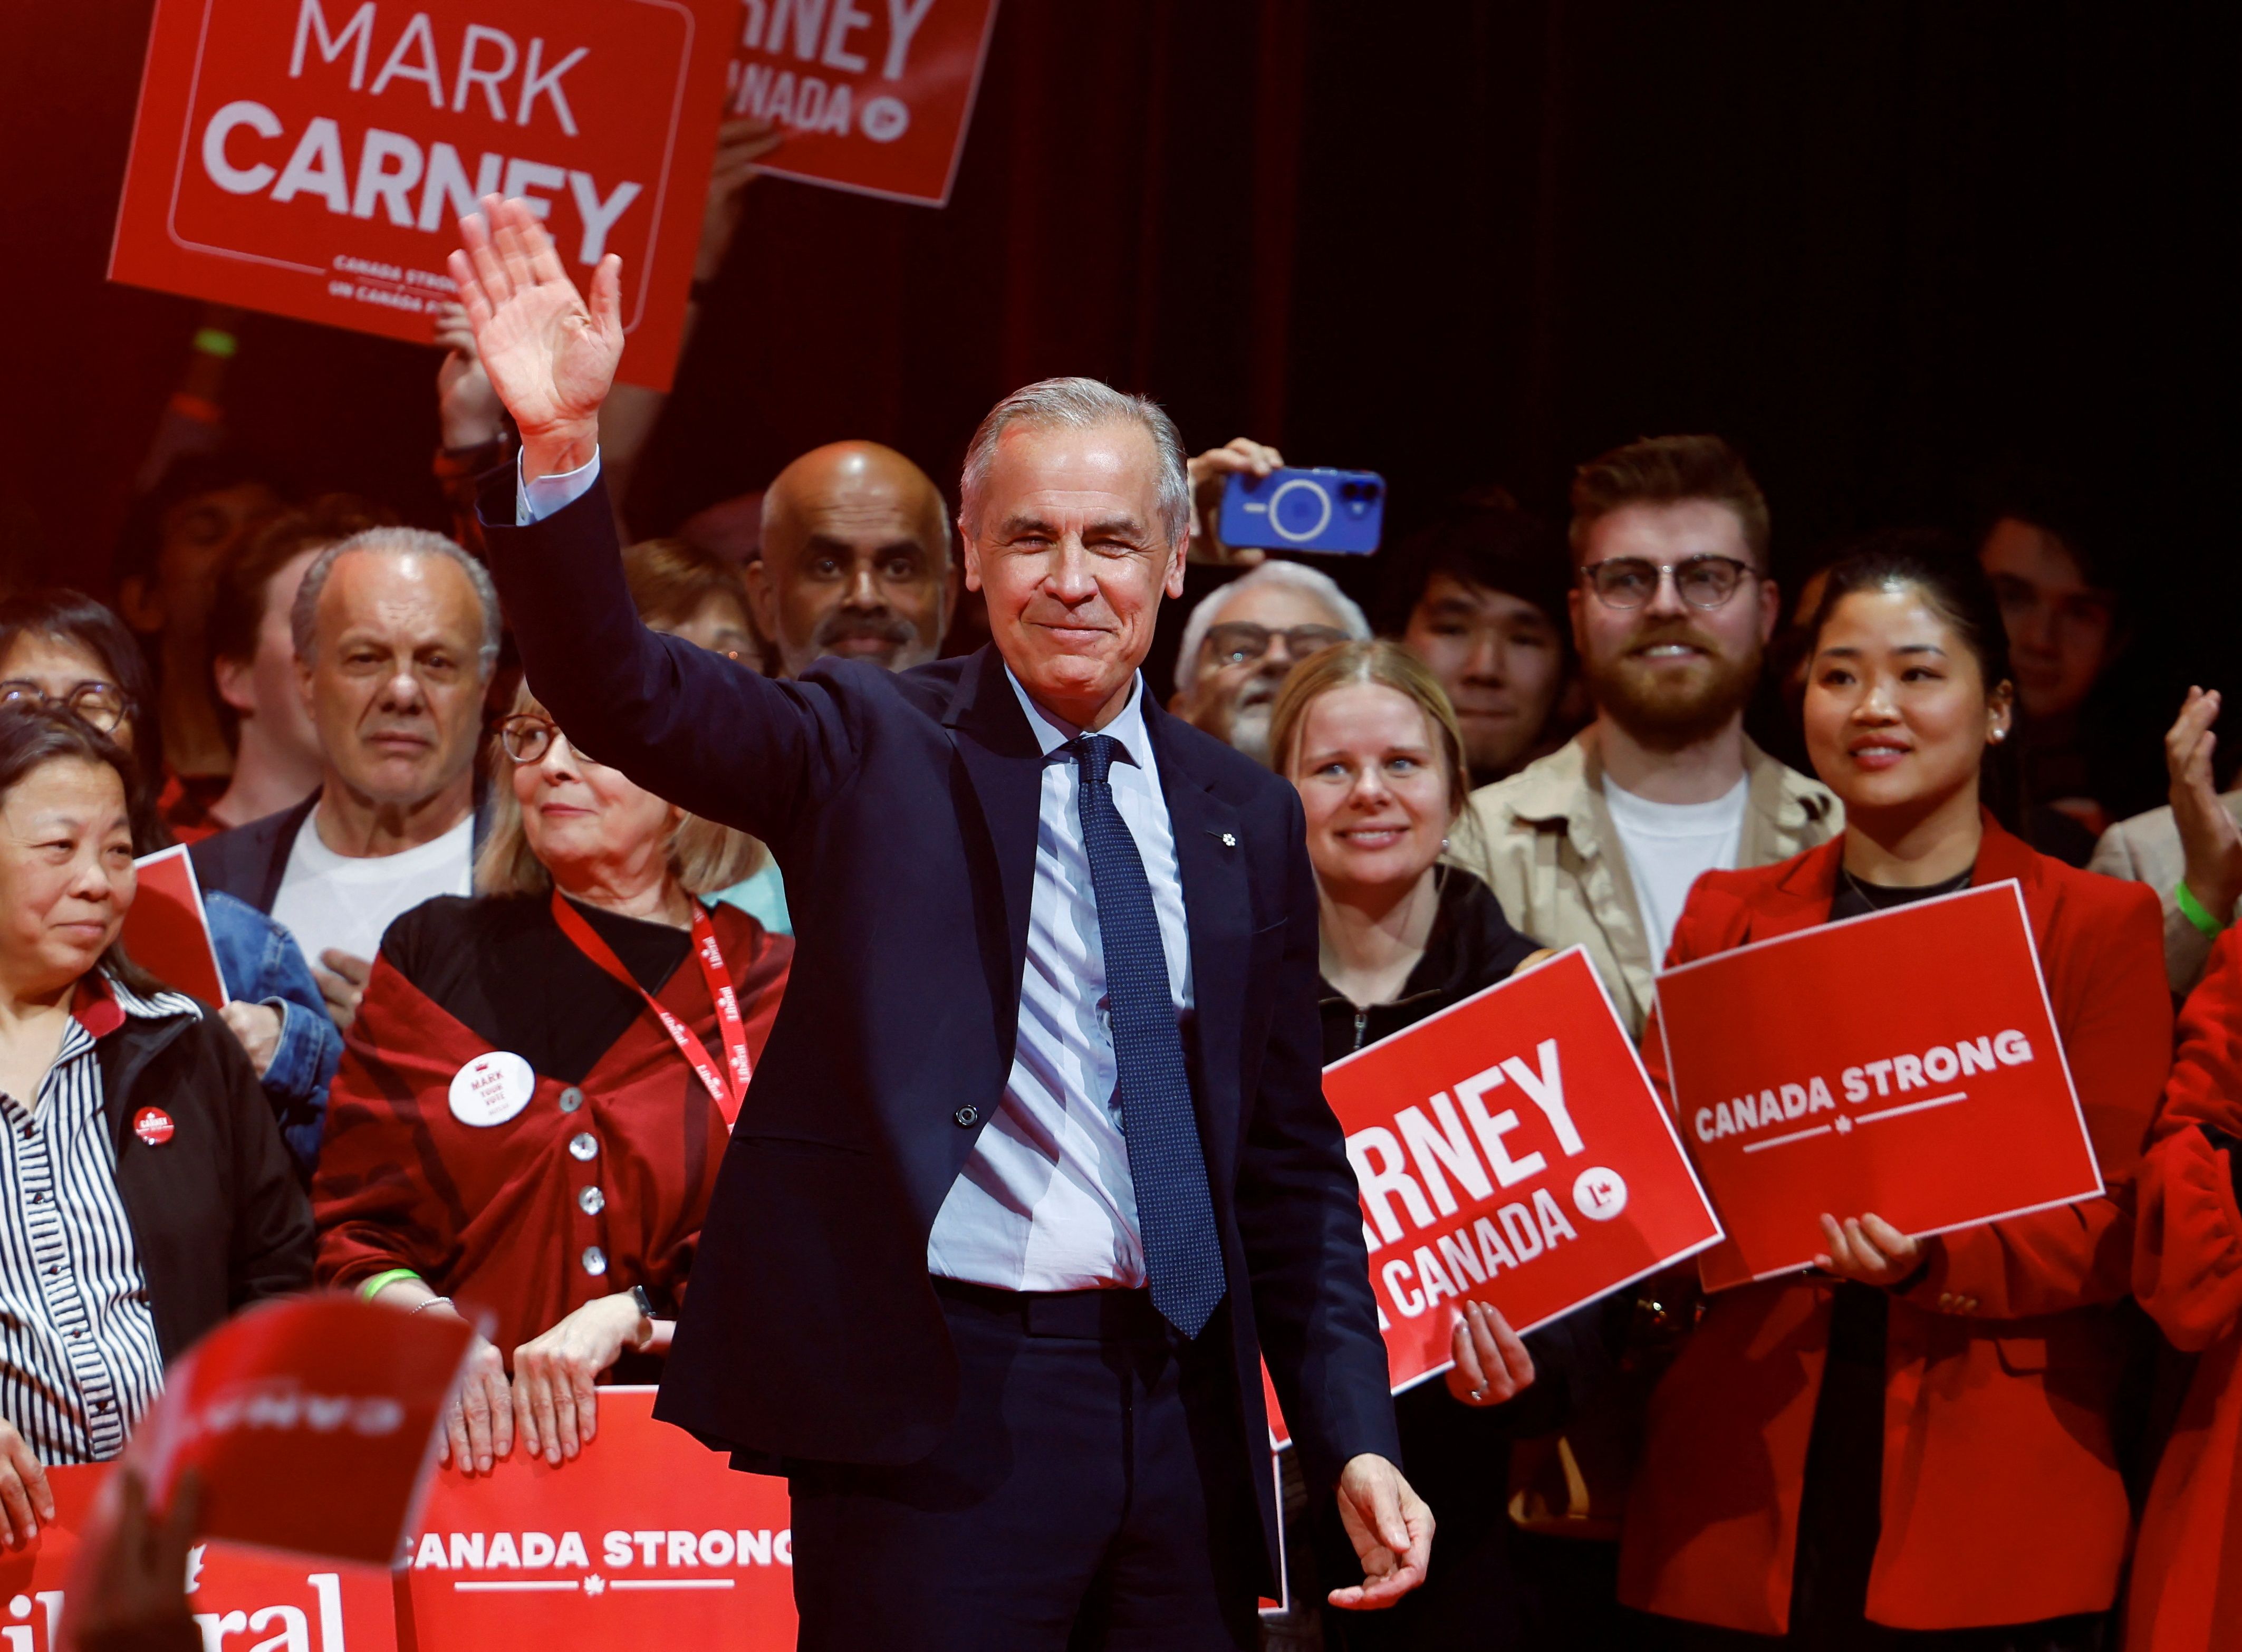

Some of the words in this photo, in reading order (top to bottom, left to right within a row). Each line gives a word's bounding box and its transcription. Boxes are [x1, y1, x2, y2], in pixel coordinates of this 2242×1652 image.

[288, 0, 591, 137] MARK
[332, 254, 402, 282] CANADA
[355, 285, 423, 312] CANADA
[1345, 1037, 1586, 1254] RNEY
[1695, 1075, 1836, 1143] CANADA
[1841, 1029, 2034, 1104] STRONG
[1381, 1187, 1578, 1318] CANADA
